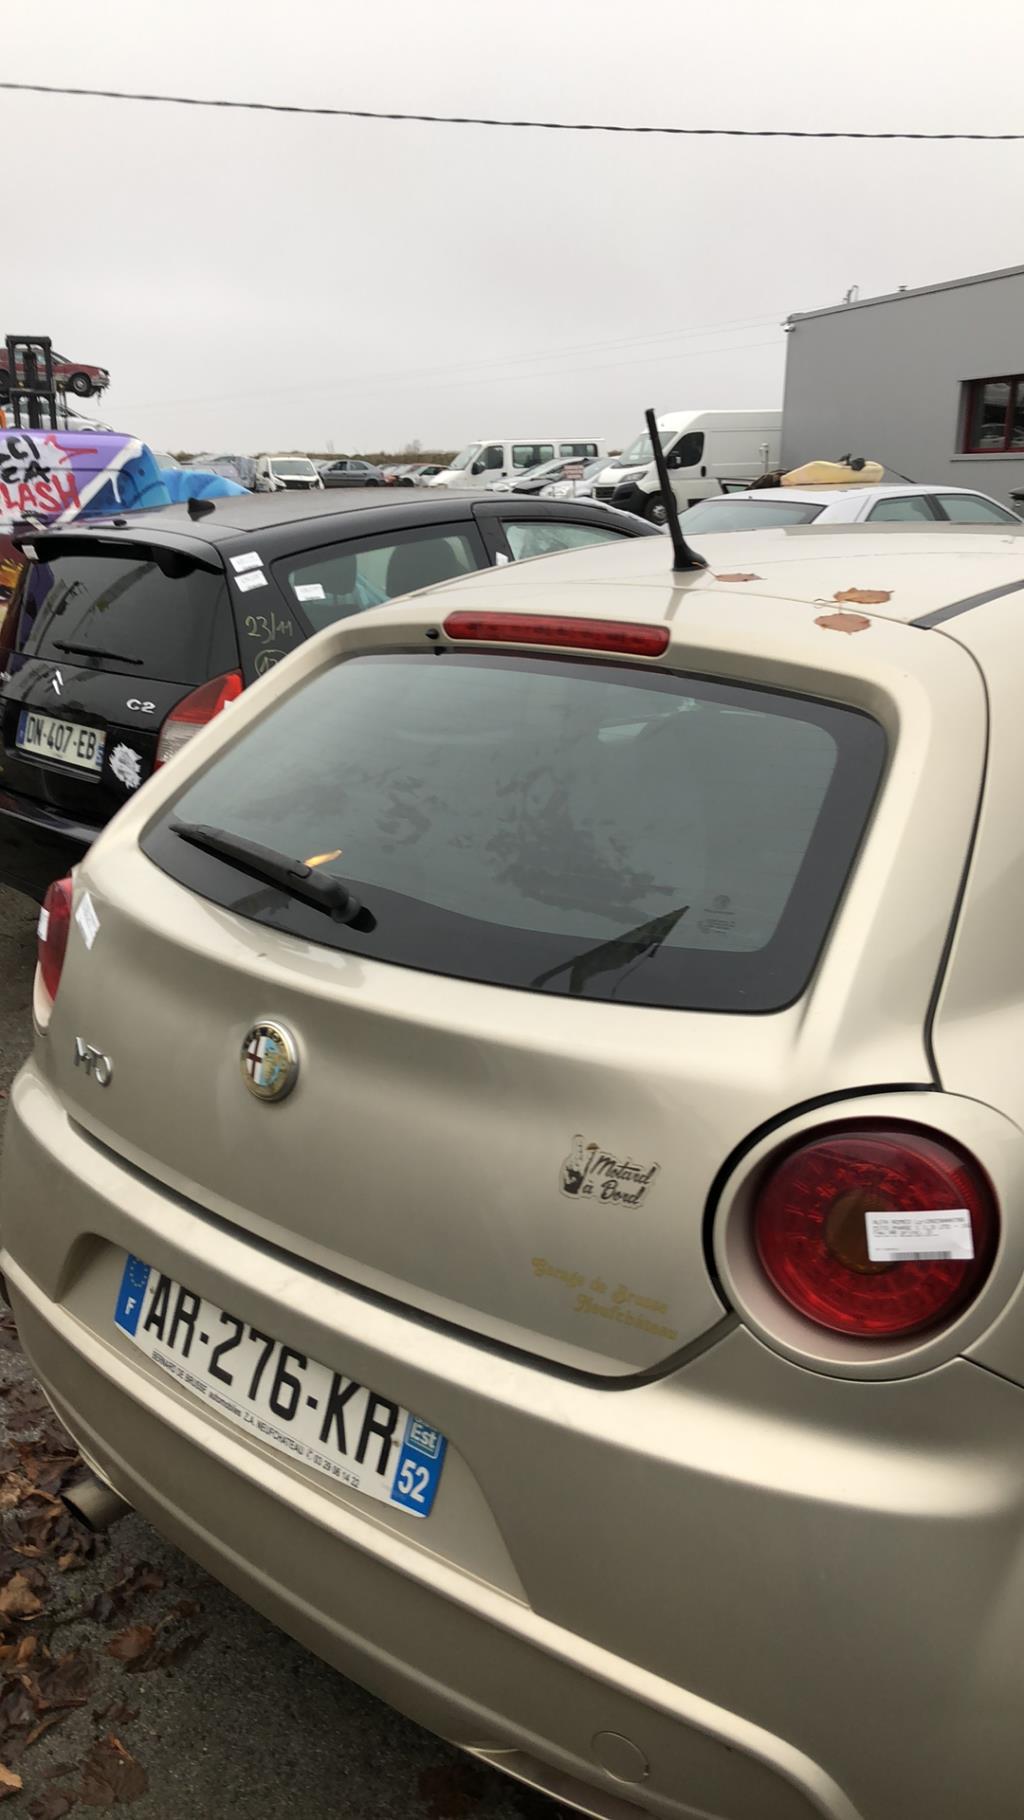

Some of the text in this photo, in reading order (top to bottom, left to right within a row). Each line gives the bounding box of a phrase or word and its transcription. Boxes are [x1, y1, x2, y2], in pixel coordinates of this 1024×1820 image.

[126, 698, 156, 714] C2
[26, 717, 97, 760] DN-407-EB
[590, 1155, 656, 1185] Motard
[601, 1180, 645, 1204] Bord
[125, 1296, 137, 1315] F
[143, 1274, 399, 1476] AR-276-KR
[410, 1422, 437, 1449] Est
[398, 1459, 430, 1503] 52
